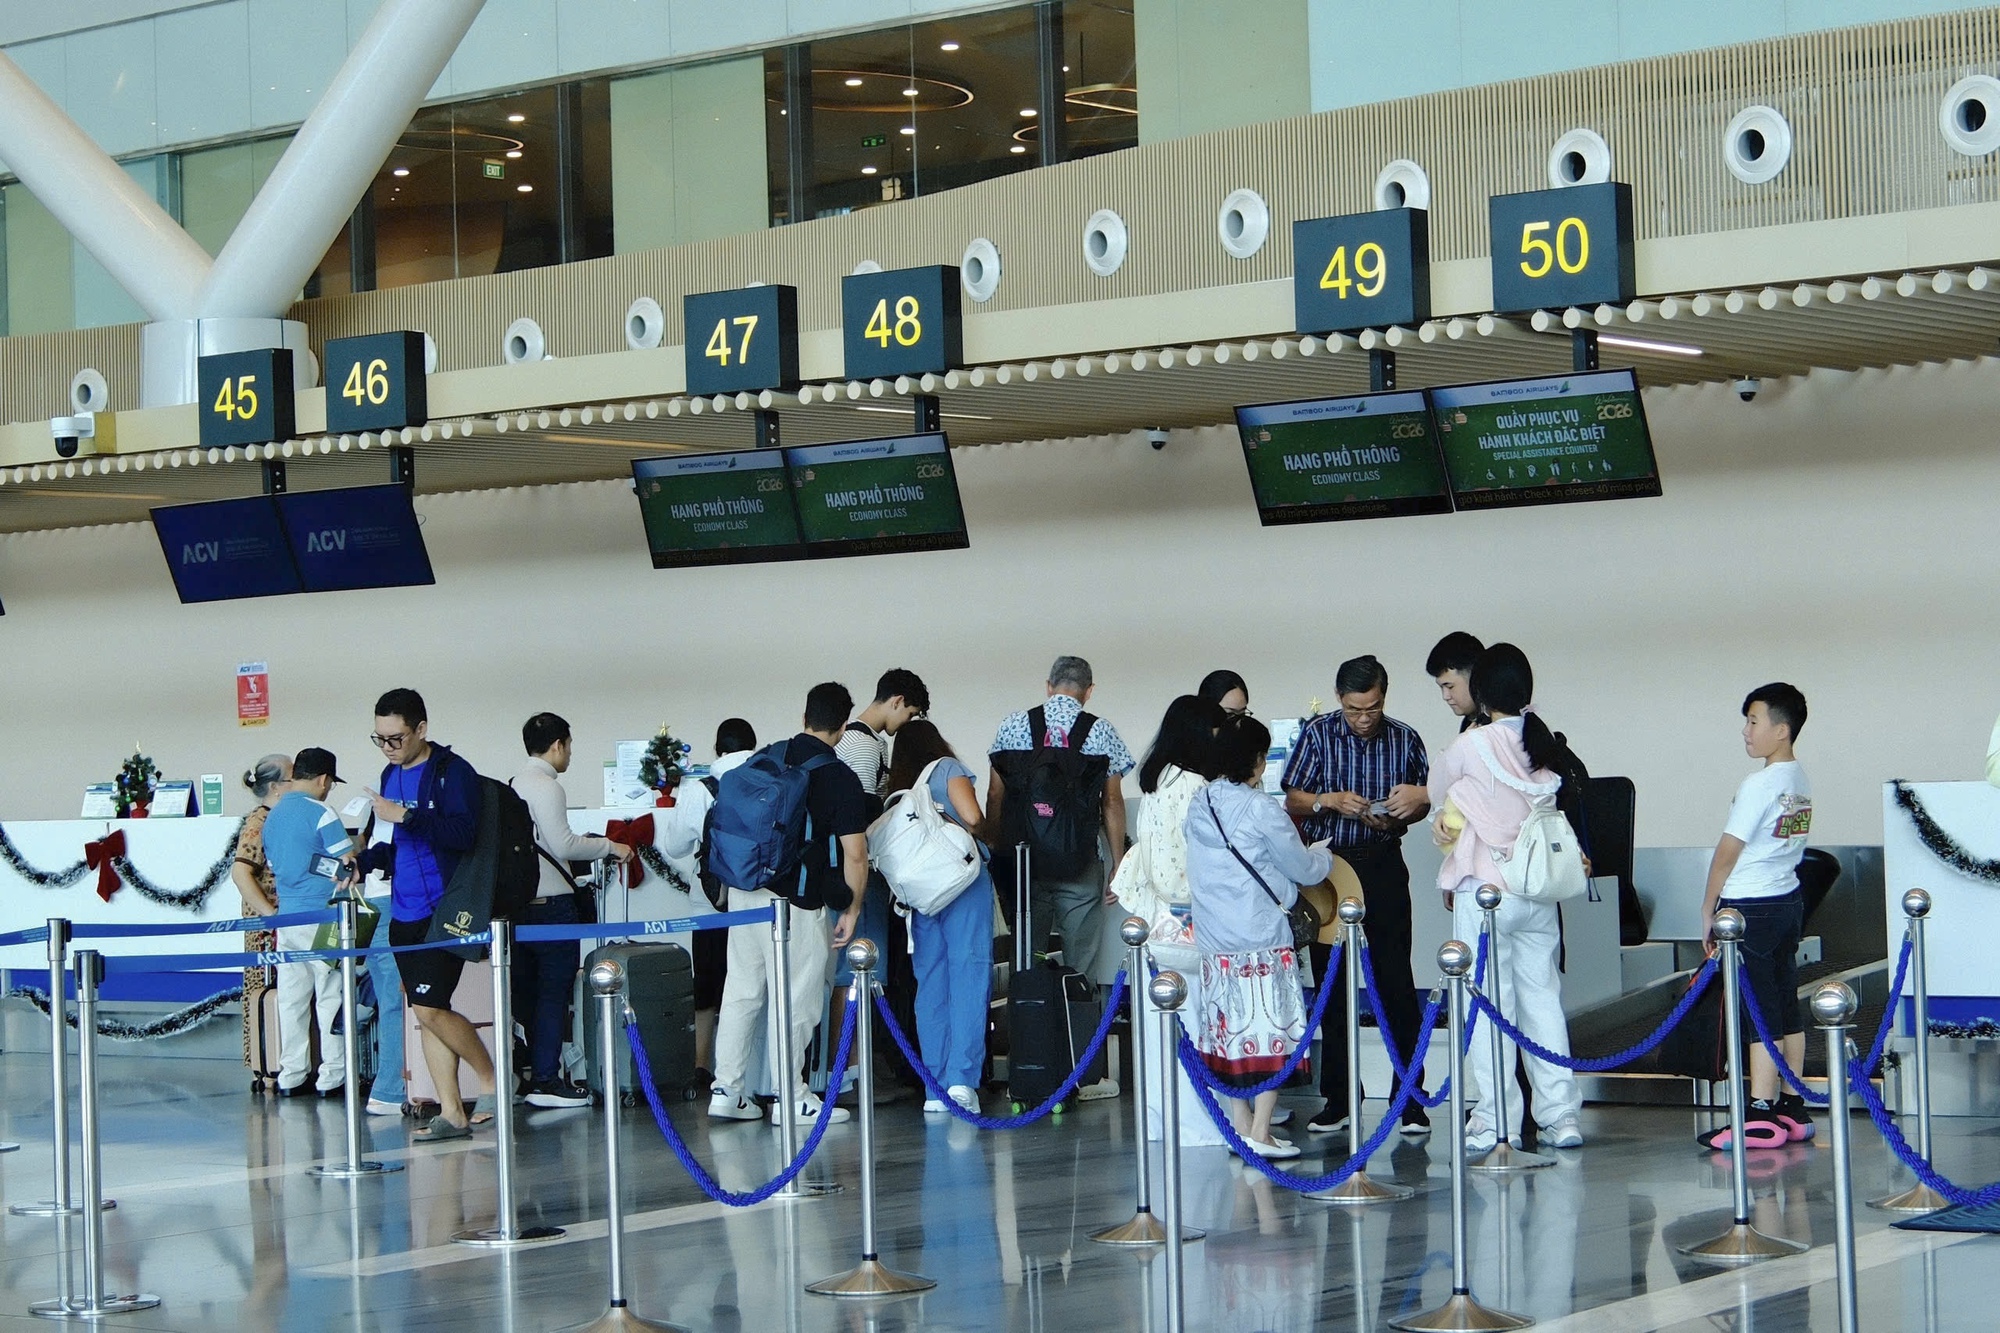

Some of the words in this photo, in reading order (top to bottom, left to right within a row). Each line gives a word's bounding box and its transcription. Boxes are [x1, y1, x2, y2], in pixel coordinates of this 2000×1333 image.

[486, 165, 500, 176] EXIT
[1520, 217, 1589, 278] 50
[1320, 242, 1386, 299] 49
[864, 296, 922, 348] 48
[705, 315, 758, 366] 47
[342, 359, 389, 406] 46
[1491, 388, 1523, 397] BAMBOO
[1526, 385, 1558, 393] AIRWAYS
[214, 375, 258, 421] 45
[1325, 404, 1355, 413] AIRWAYS
[1596, 403, 1633, 420] 2026
[1496, 410, 1527, 429] QUẦY
[1529, 411, 1561, 428] PHỤC
[1563, 409, 1579, 425] VỤ
[1391, 423, 1425, 439] 2026
[1478, 432, 1511, 450] HÀNH
[1513, 430, 1553, 447] KHÁCH
[1554, 425, 1579, 445] ĐẶC
[1581, 423, 1605, 443] BIỆT
[1283, 453, 1321, 474] HẠNG
[1324, 444, 1350, 467] PHỔ
[1352, 444, 1400, 465] THÔNG
[1493, 450, 1522, 461] SPECIAL
[1522, 447, 1565, 459] ASSISTANCE
[1566, 444, 1599, 455] COUNTER
[916, 464, 945, 478] 2026
[1311, 473, 1353, 485] ECONOMY
[1353, 471, 1380, 482] CLASS
[757, 478, 783, 492] 2026
[1564, 486, 1594, 497] closes
[825, 489, 857, 511] HẠNG
[859, 483, 883, 505] PHỔ
[884, 483, 924, 502] THÔNG
[671, 501, 700, 521] HẠNG
[703, 496, 725, 516] PHỔ
[727, 496, 764, 515] THÔNG
[849, 510, 884, 522] ECONOMY
[884, 508, 907, 518] CLASS
[693, 521, 726, 533] ECONOMY
[726, 520, 748, 530] CLASS
[307, 529, 346, 552] ACV
[183, 541, 219, 565] ACV
[206, 920, 235, 932] ACV
[645, 920, 667, 934] ACV
[257, 952, 287, 965] ACV
